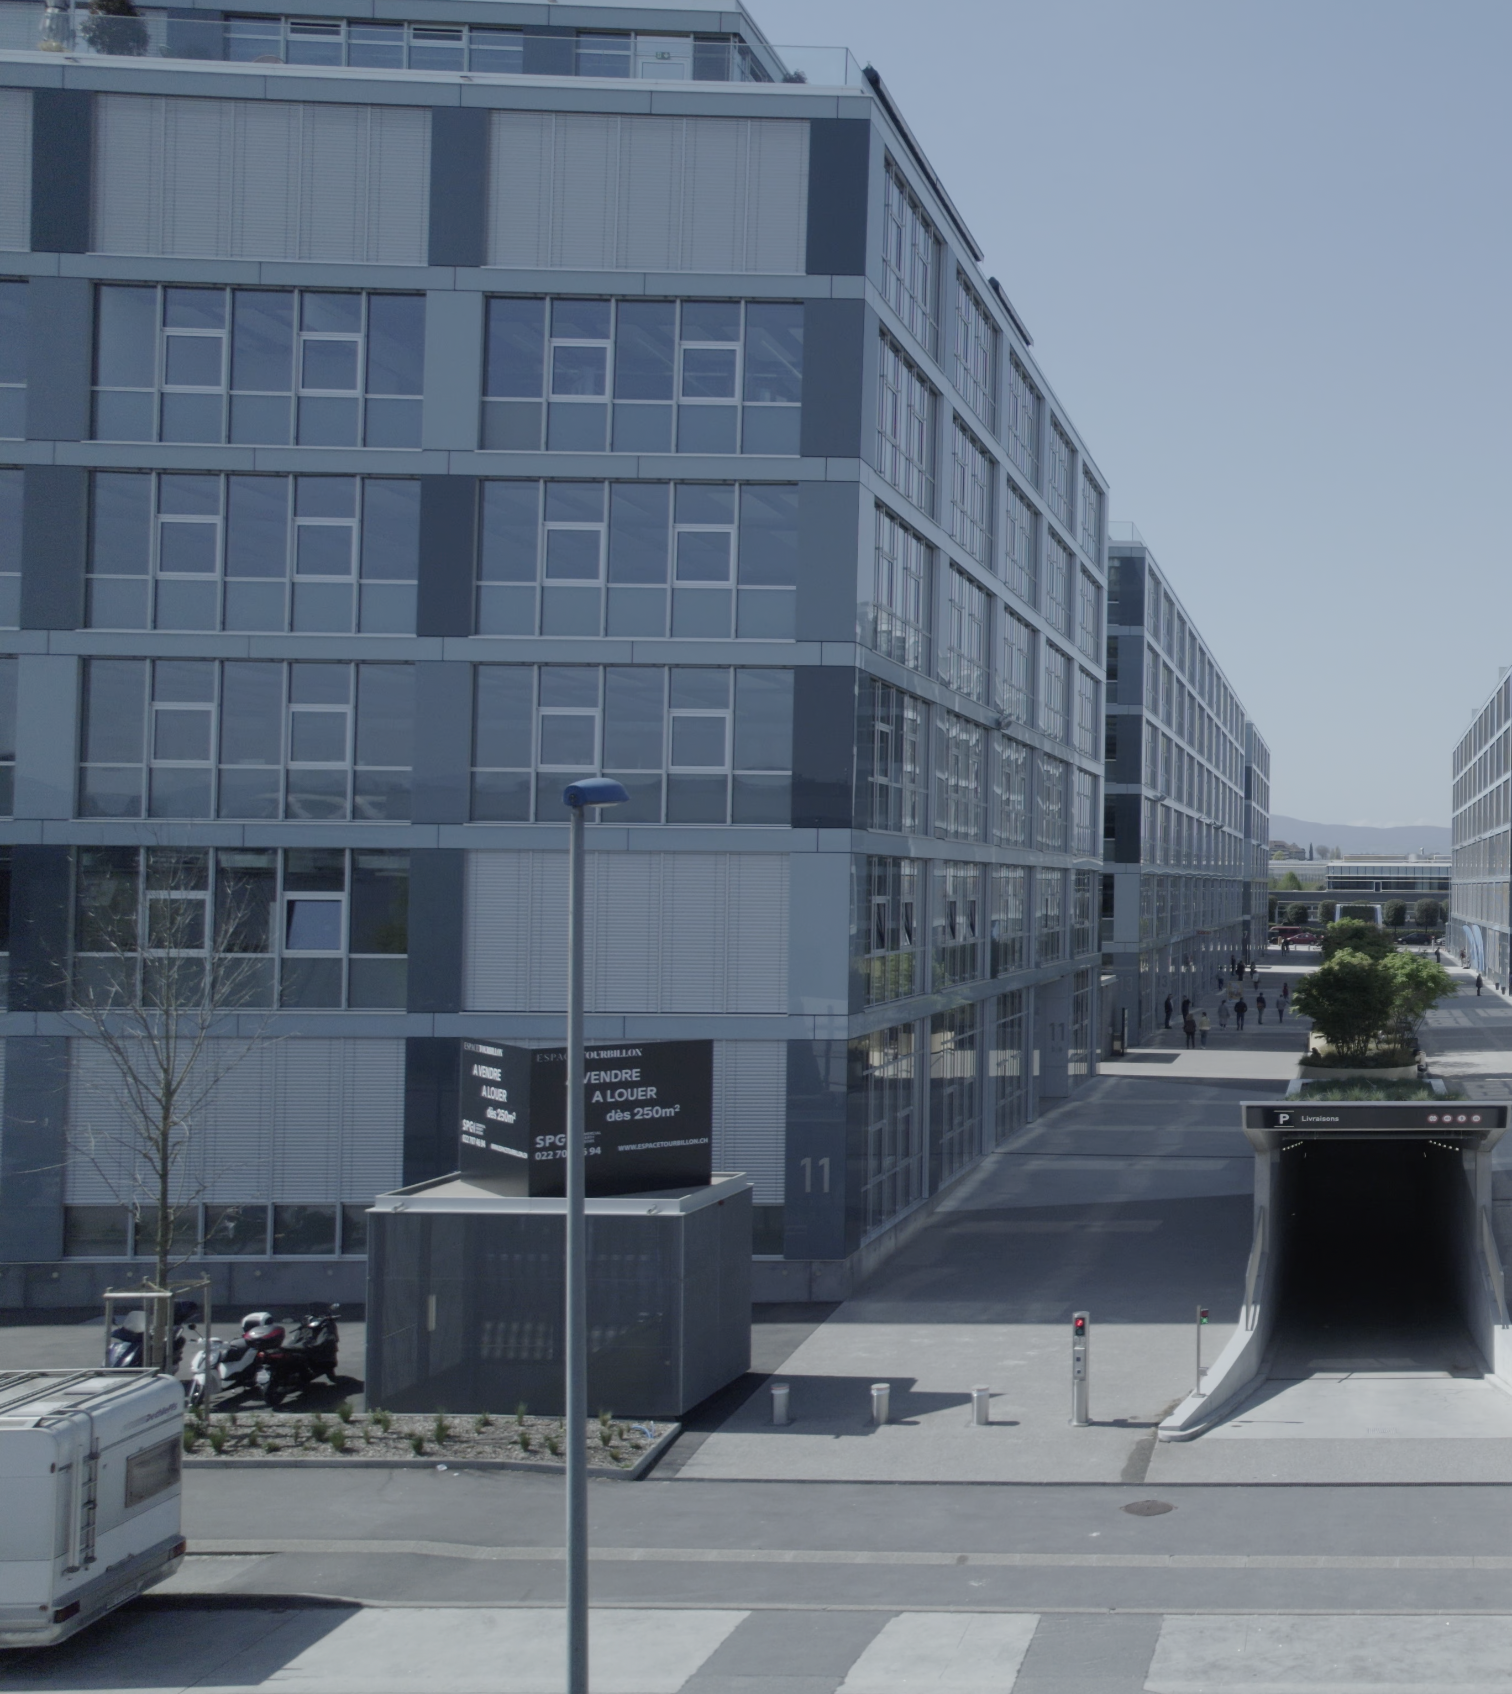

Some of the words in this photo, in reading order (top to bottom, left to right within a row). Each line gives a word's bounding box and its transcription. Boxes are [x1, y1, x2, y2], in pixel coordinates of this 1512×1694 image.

[472, 1063, 478, 1076] A
[478, 1064, 502, 1081] VENDRE
[481, 1084, 487, 1097] A
[487, 1085, 507, 1102] LOUER
[591, 1091, 604, 1103] A
[607, 1087, 657, 1102] LOUER
[606, 1109, 631, 1122] dès
[633, 1104, 681, 1120] 250m²
[1279, 1113, 1290, 1125] P
[535, 1133, 566, 1148] SPG
[617, 1137, 709, 1151] WWW.ESPACETOURBILLON.CH
[534, 1151, 554, 1160] 022
[555, 1149, 568, 1159] 70
[589, 1146, 602, 1156] 94
[800, 1157, 830, 1193] 11
